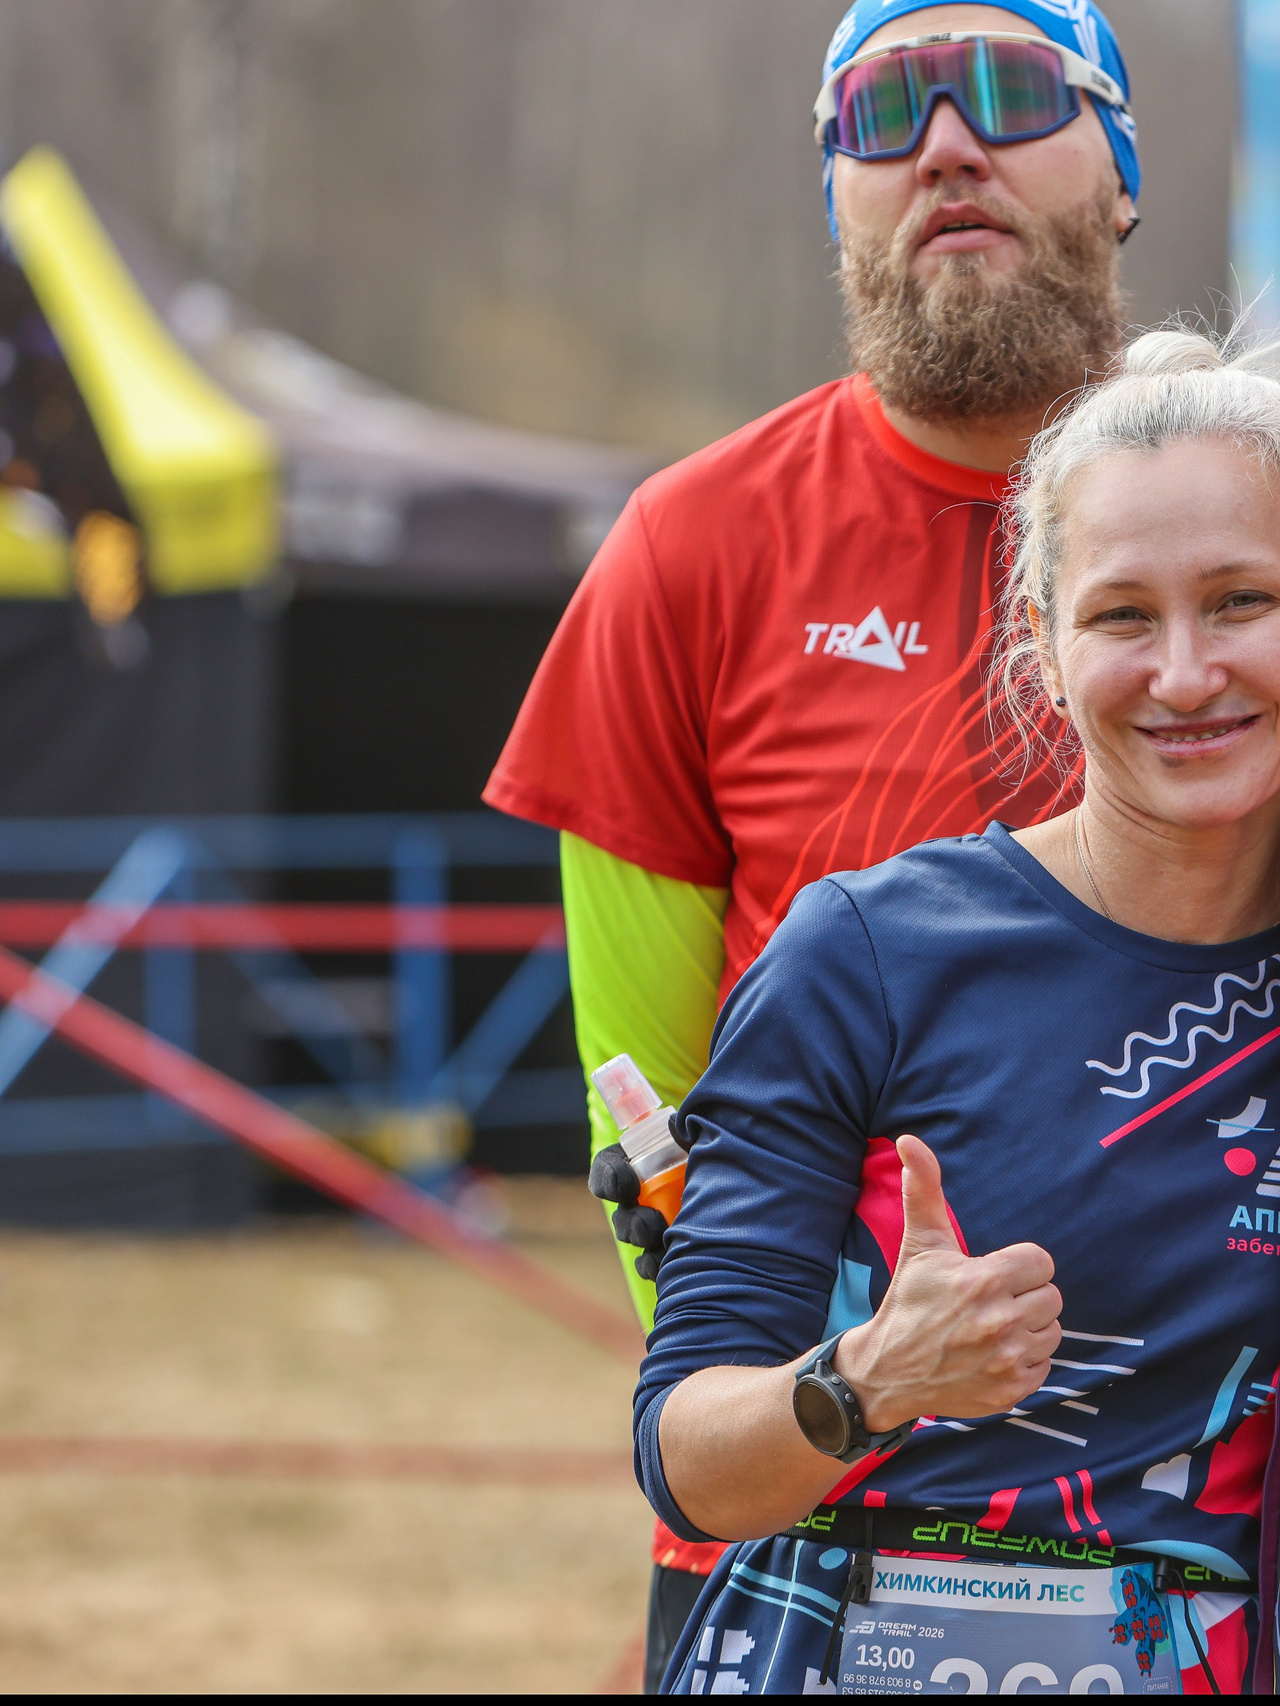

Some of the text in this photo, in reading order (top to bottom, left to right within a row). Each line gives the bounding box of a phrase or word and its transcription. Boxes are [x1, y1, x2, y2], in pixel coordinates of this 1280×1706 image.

[804, 605, 929, 672] TRAIL
[874, 1571, 1085, 1602] ХИМКИНСКИЙ ЛЕС
[877, 1621, 917, 1631] DREAM
[881, 1629, 912, 1637] TRAIL
[917, 1626, 945, 1639] 2026
[855, 1644, 915, 1672] 13,00
[843, 1673, 855, 1683] 99
[856, 1674, 868, 1685] 36
[869, 1675, 885, 1686] 978
[905, 1679, 911, 1688] 8
[1147, 1681, 1170, 1692] ПИТАНИЕ
